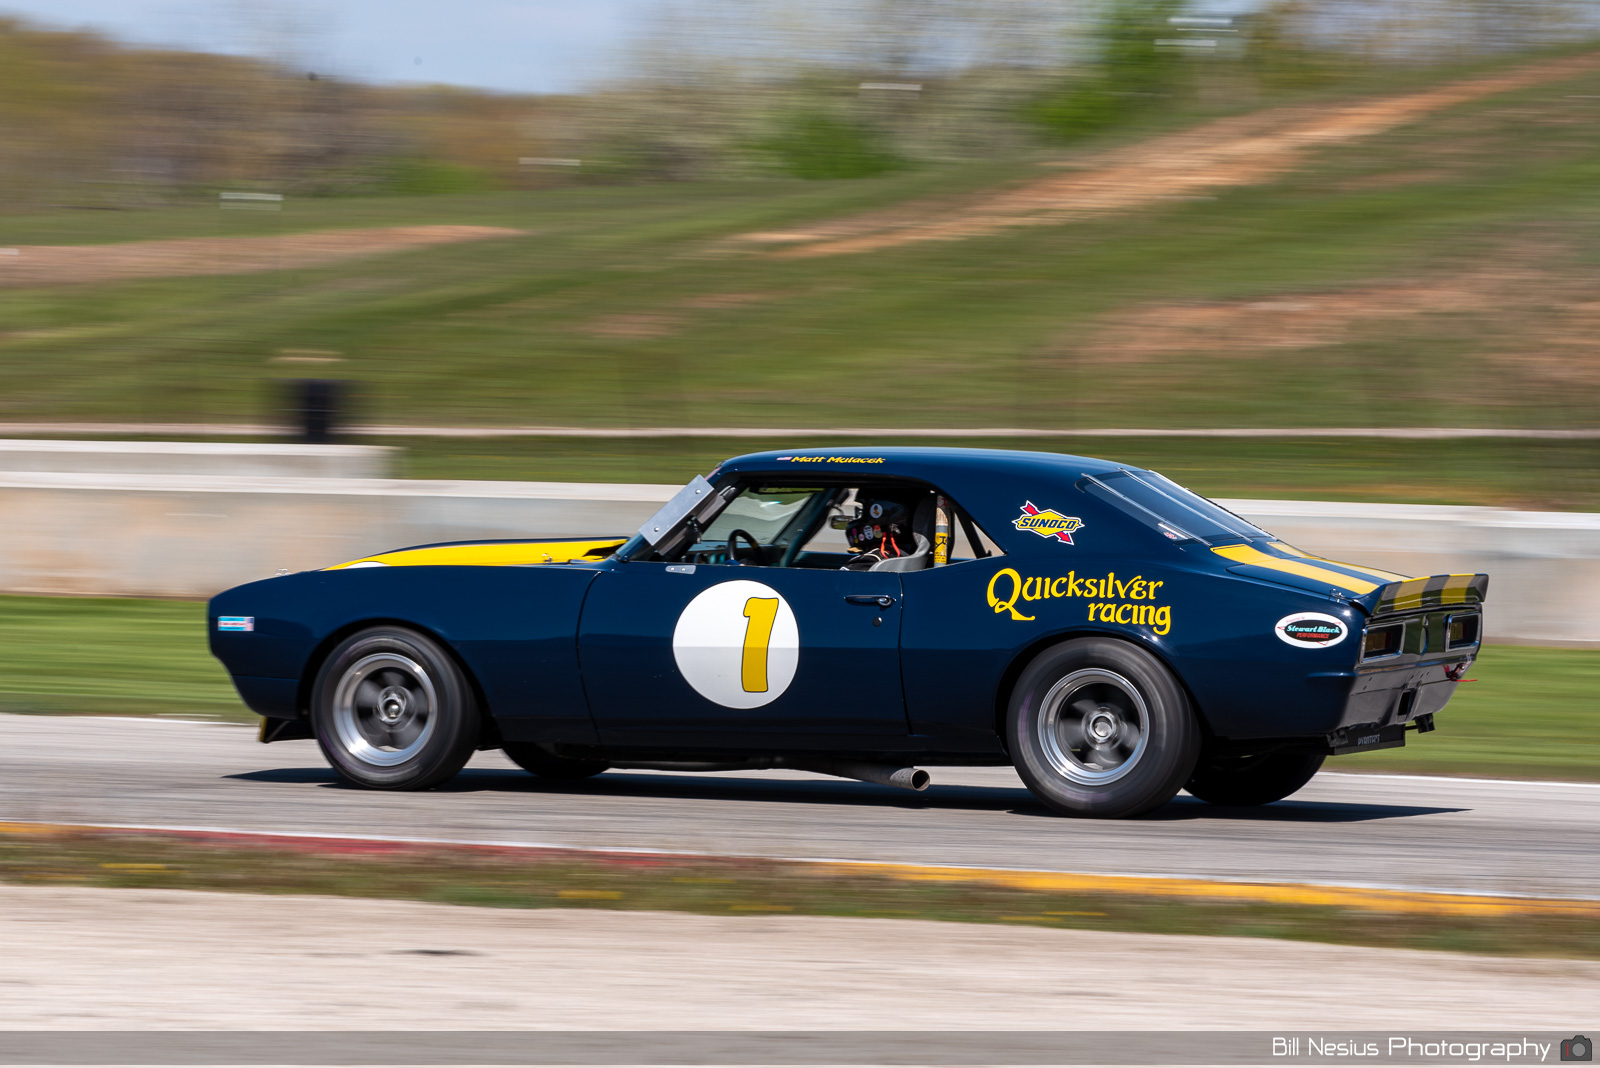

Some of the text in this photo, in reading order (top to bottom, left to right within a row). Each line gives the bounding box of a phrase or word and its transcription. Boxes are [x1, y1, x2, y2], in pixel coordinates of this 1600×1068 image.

[826, 456, 886, 464] Mulacek
[1020, 517, 1078, 530] SUNOCO
[986, 567, 1164, 621] Quicksilver
[1088, 602, 1172, 636] racing
[1286, 624, 1340, 634] Stewart Black
[741, 596, 779, 693] 1
